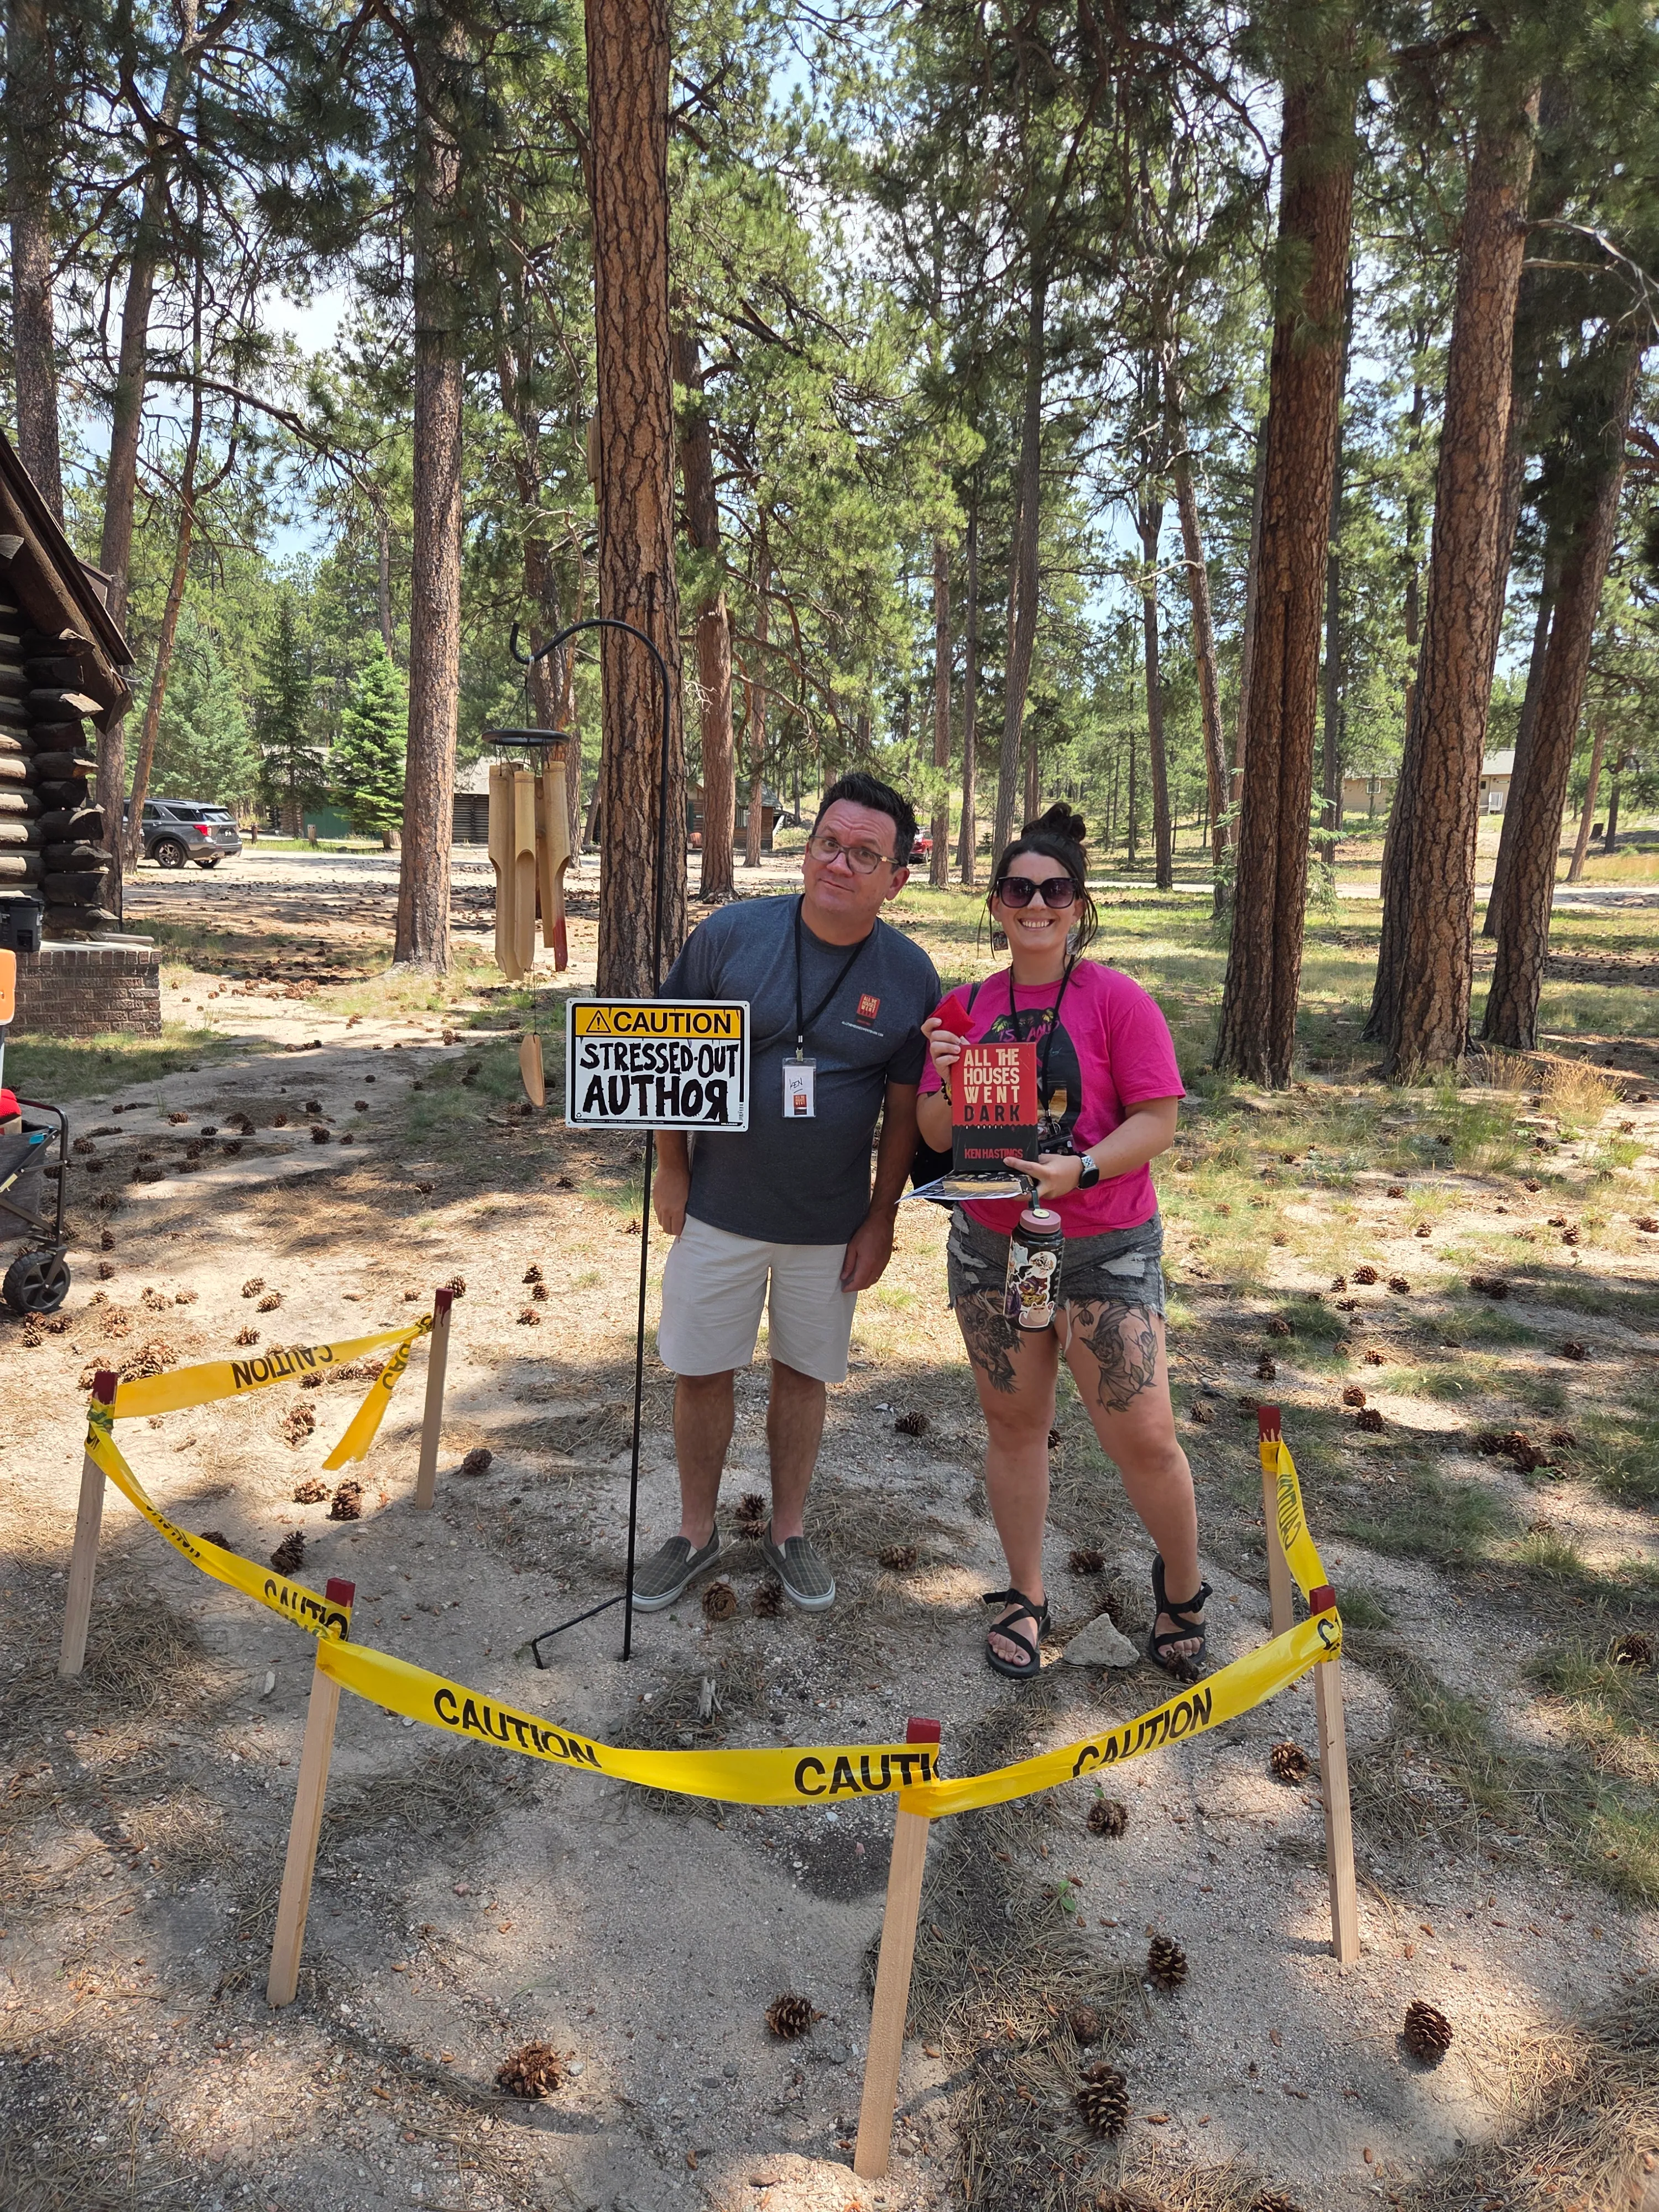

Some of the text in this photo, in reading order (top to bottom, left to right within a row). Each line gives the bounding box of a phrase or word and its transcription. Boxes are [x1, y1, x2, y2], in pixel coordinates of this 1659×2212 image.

[613, 1011, 731, 1034] CAUTION
[580, 1041, 739, 1078] STRESSED-OUT
[964, 1048, 1019, 1067] ALL THE
[789, 1077, 803, 1090] KEN
[964, 1067, 1020, 1085] HOUSES
[964, 1086, 1020, 1104] WENT
[964, 1105, 1020, 1122] DARK
[964, 1148, 1023, 1159] KEN HASTINGS
[230, 1344, 333, 1389] CAUTION
[264, 1579, 349, 1642] CAUTIO
[434, 1688, 603, 1769] CAUTION
[1072, 1687, 1212, 1778] CAUTION
